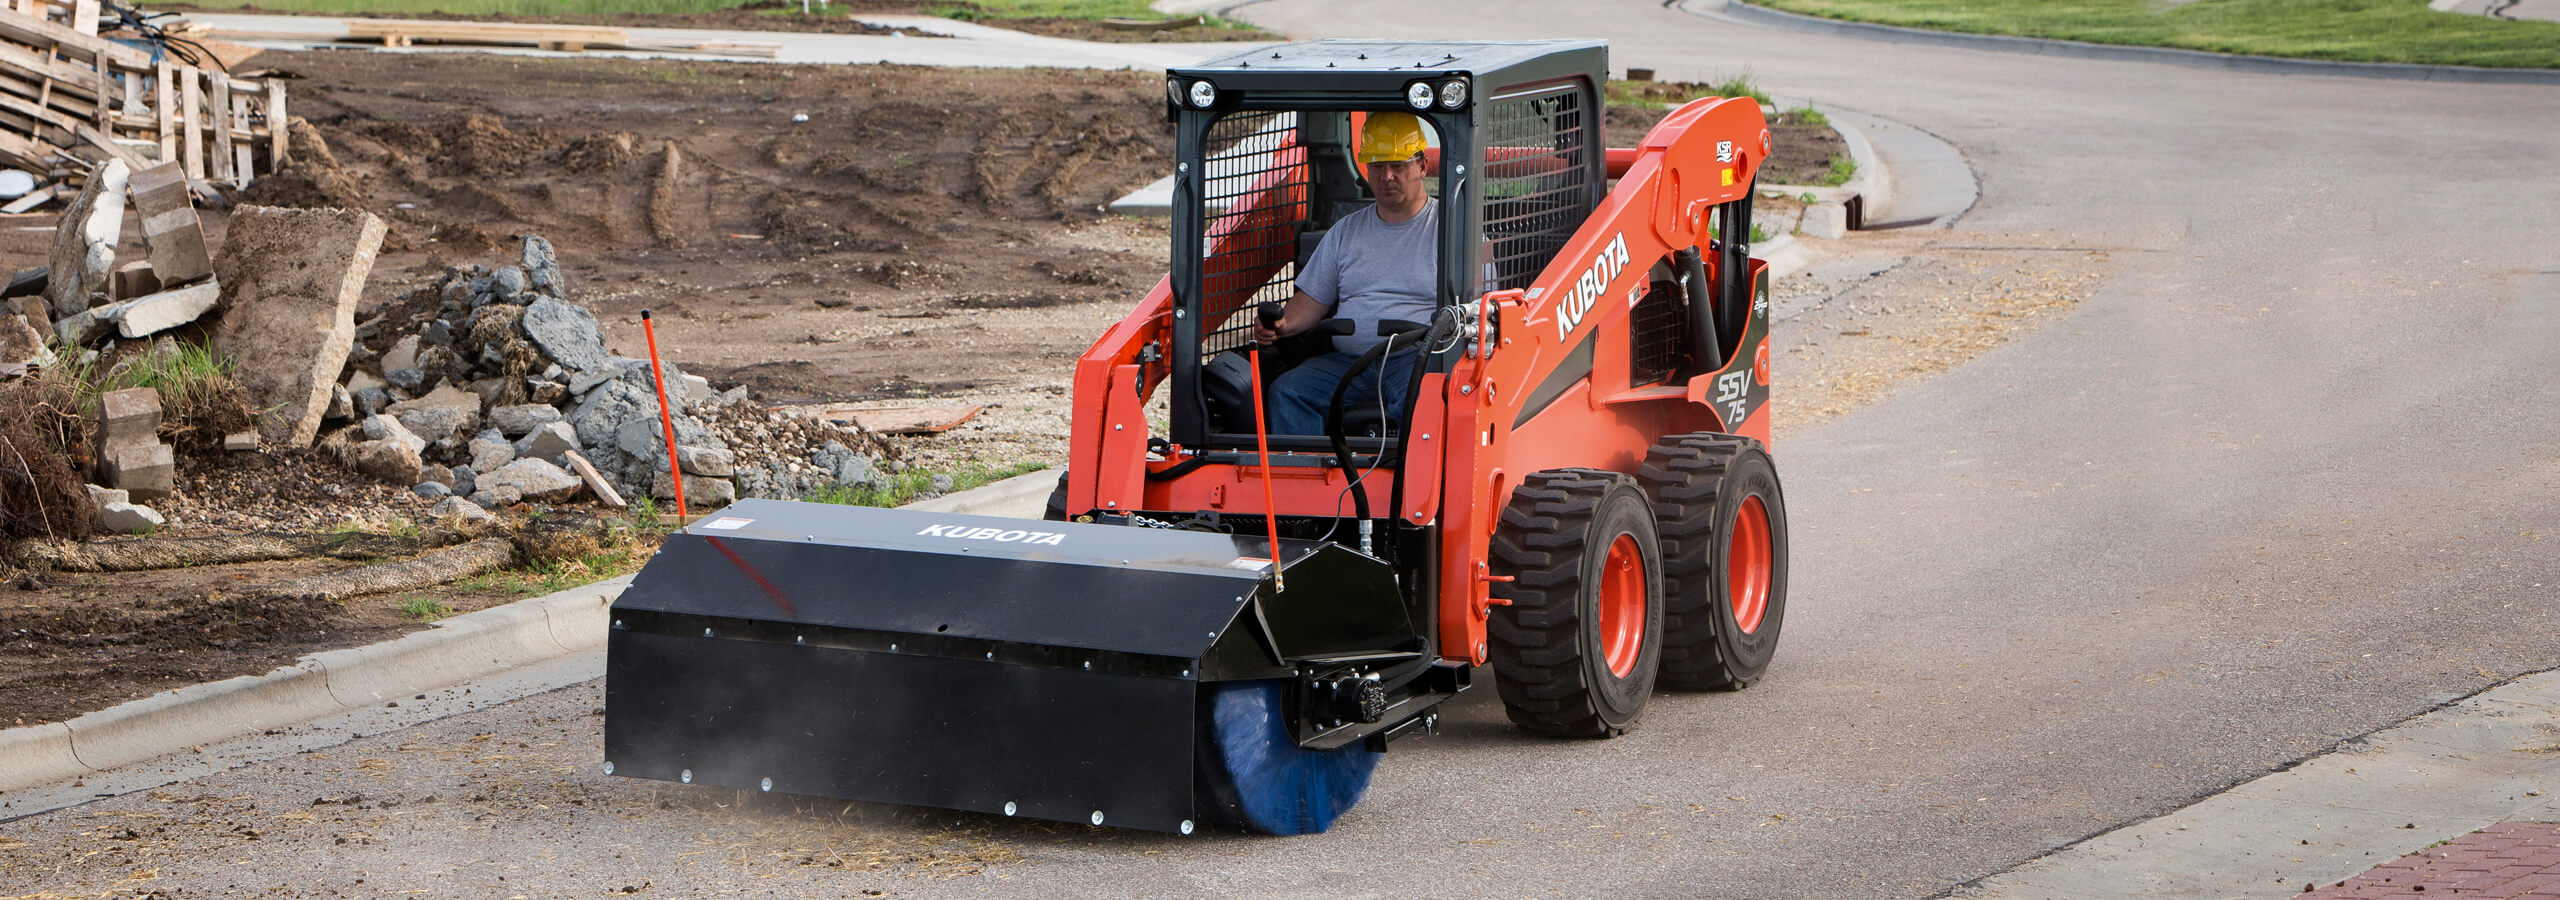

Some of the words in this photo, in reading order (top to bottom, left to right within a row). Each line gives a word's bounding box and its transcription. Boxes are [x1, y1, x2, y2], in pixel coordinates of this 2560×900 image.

[1556, 229, 1630, 343] KUBOTA
[1716, 368, 1753, 404] SSV
[1727, 398, 1746, 425] 75
[916, 524, 1067, 546] KUBOTA
